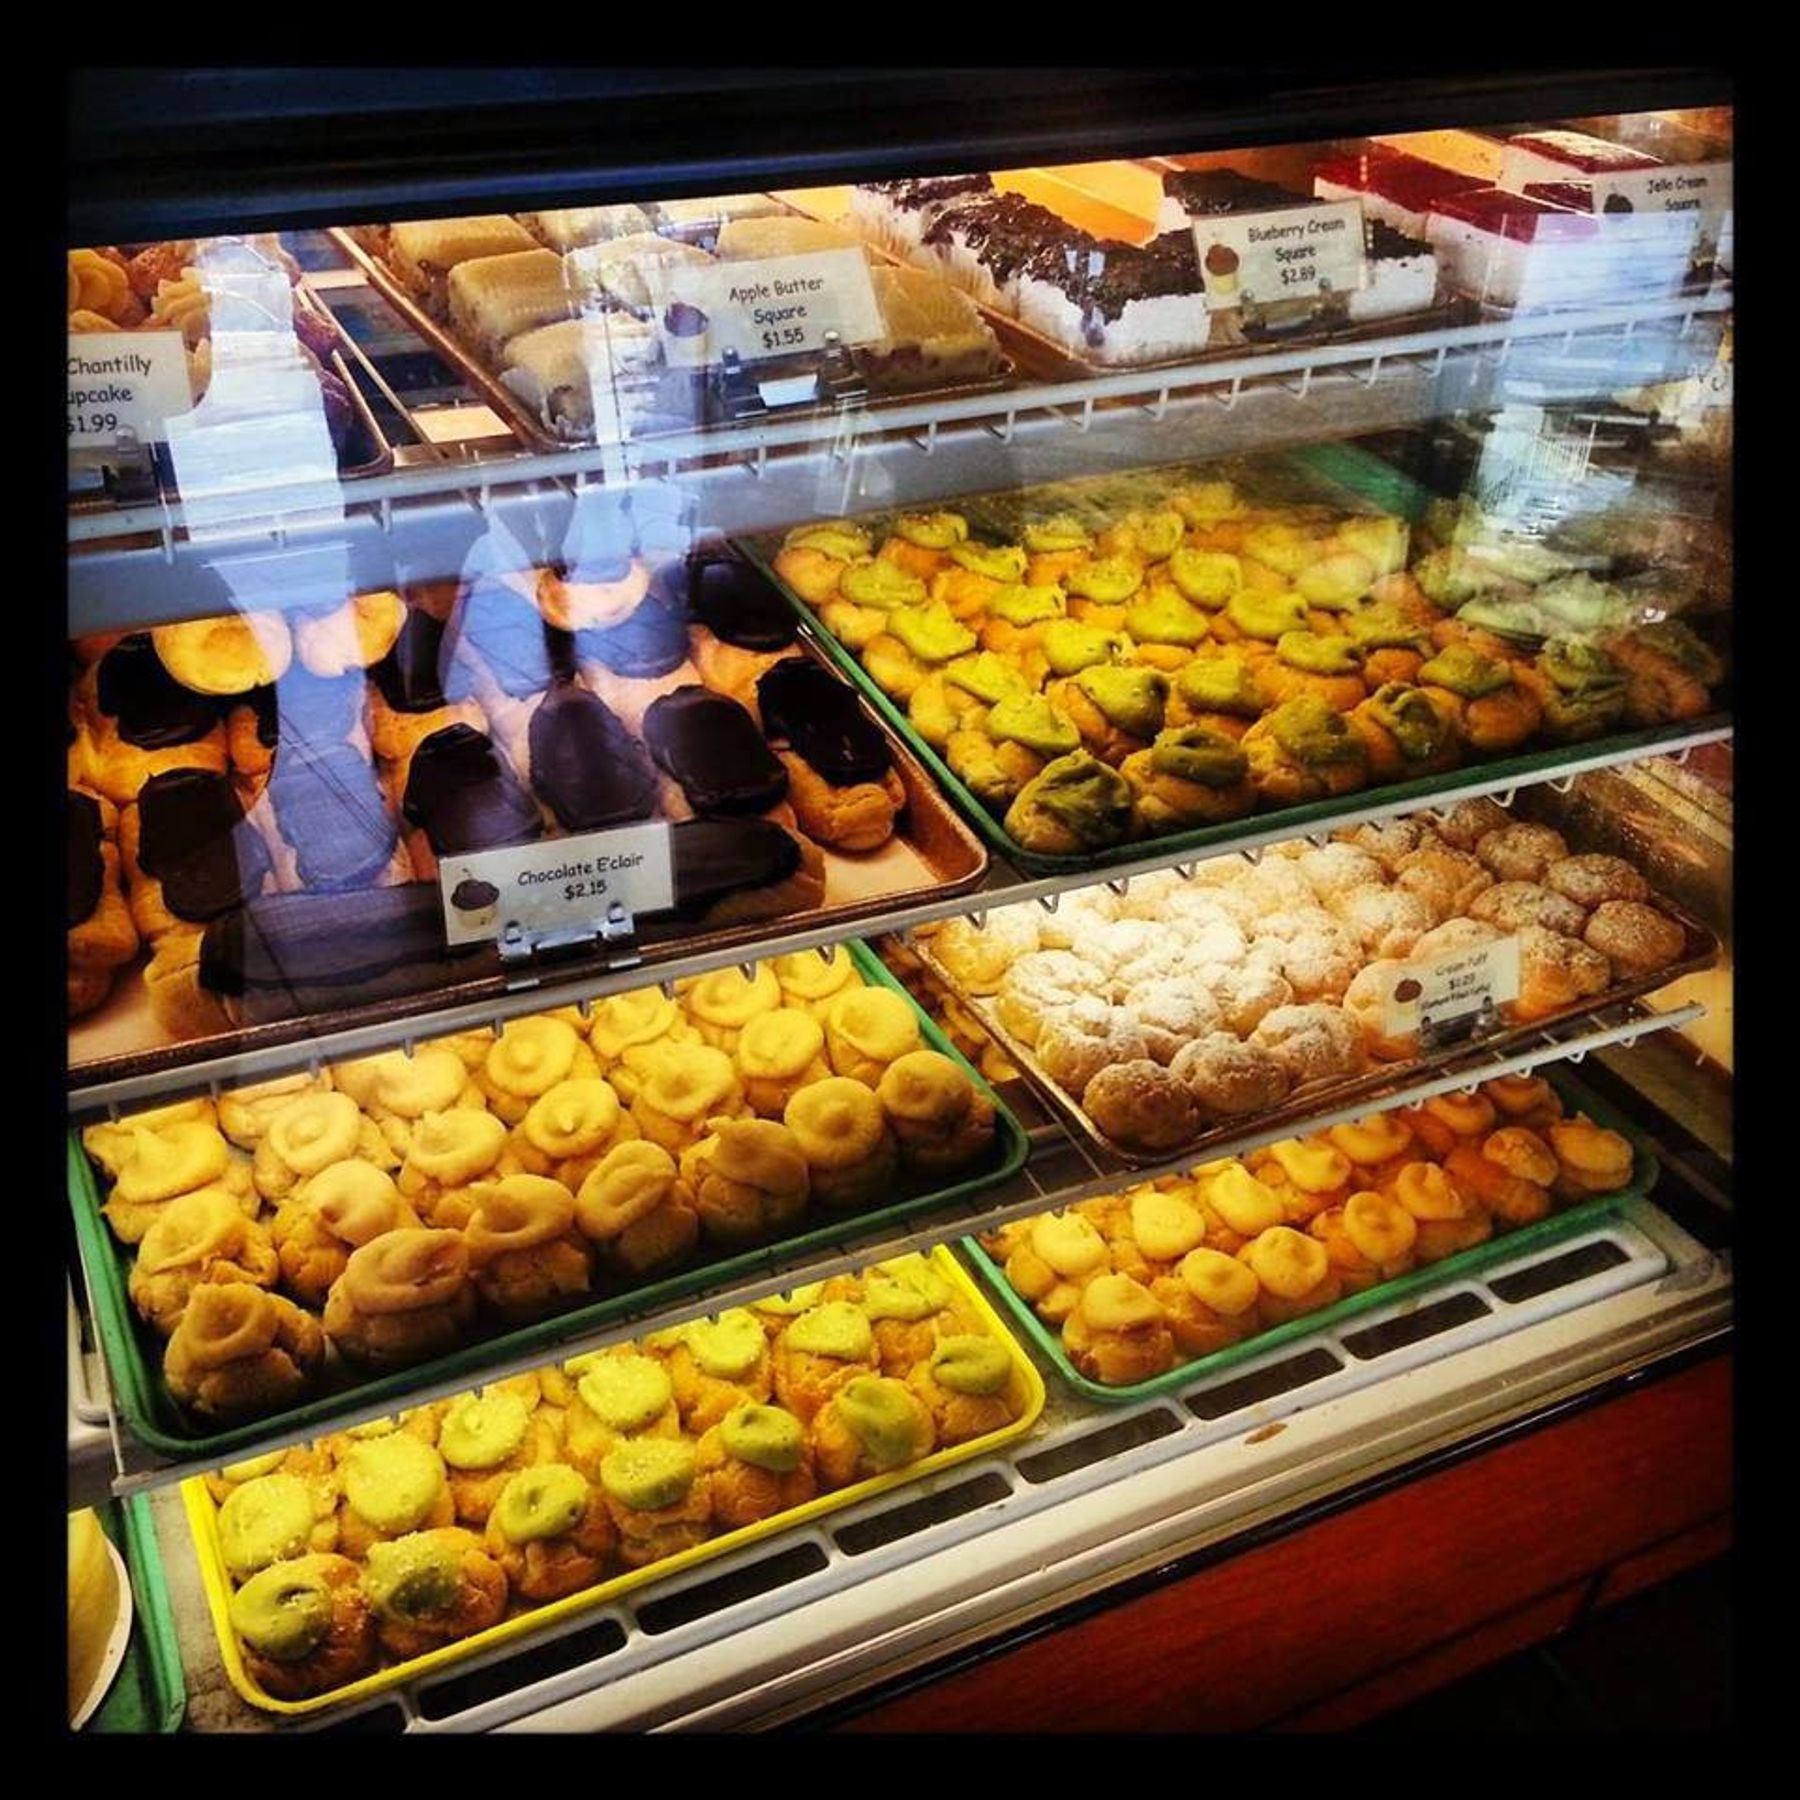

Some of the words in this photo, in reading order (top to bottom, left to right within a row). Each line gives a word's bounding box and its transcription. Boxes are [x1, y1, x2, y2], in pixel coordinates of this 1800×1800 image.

[1676, 175, 1708, 190] Cream
[1248, 224, 1304, 243] Blueberry
[1307, 218, 1346, 234] Cream
[1275, 246, 1316, 264] Square
[729, 283, 770, 305] Apple
[774, 277, 824, 297] Butter
[753, 304, 808, 326] Square
[762, 327, 805, 349] $1.55
[67, 353, 152, 377] Chantilly
[518, 861, 593, 887] Chocolate
[564, 878, 607, 901] $2.15
